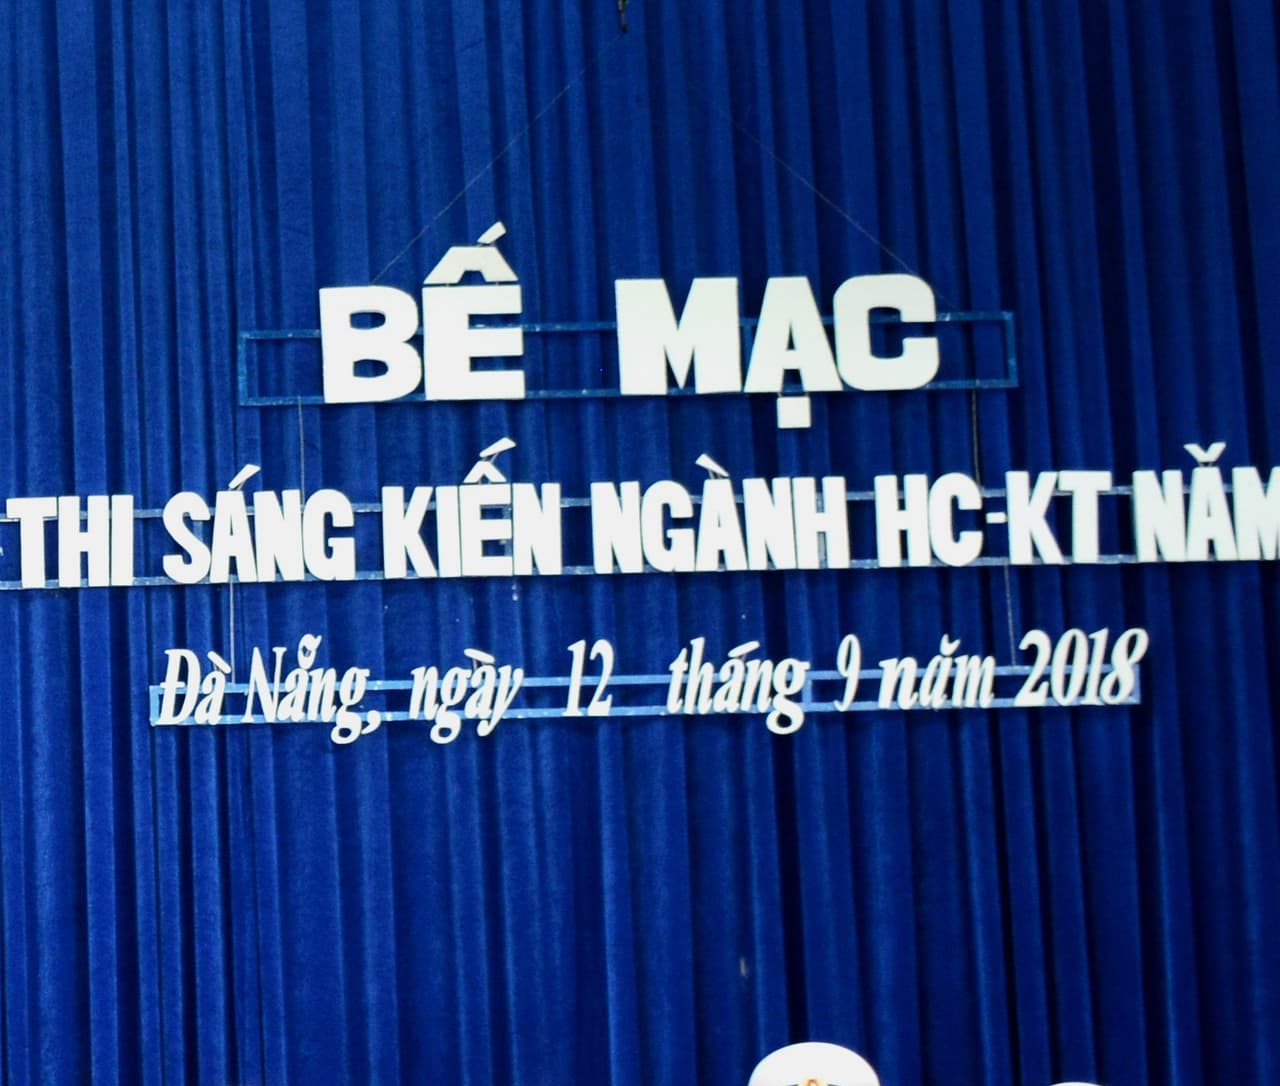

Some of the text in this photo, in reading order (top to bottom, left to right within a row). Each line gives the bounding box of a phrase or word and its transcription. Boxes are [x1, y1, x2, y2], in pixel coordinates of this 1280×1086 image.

[319, 221, 940, 429] BẾ MẠC
[6, 494, 134, 588] THI
[162, 464, 356, 585] SÁNG
[382, 437, 562, 580] KIẾN
[590, 453, 851, 575] NGÀNH
[874, 470, 1114, 568] HC-KT
[1132, 442, 1280, 563] NĂM
[157, 628, 1150, 744] Đà Nẵng, ngày 12 tháng 9 năm 2018
